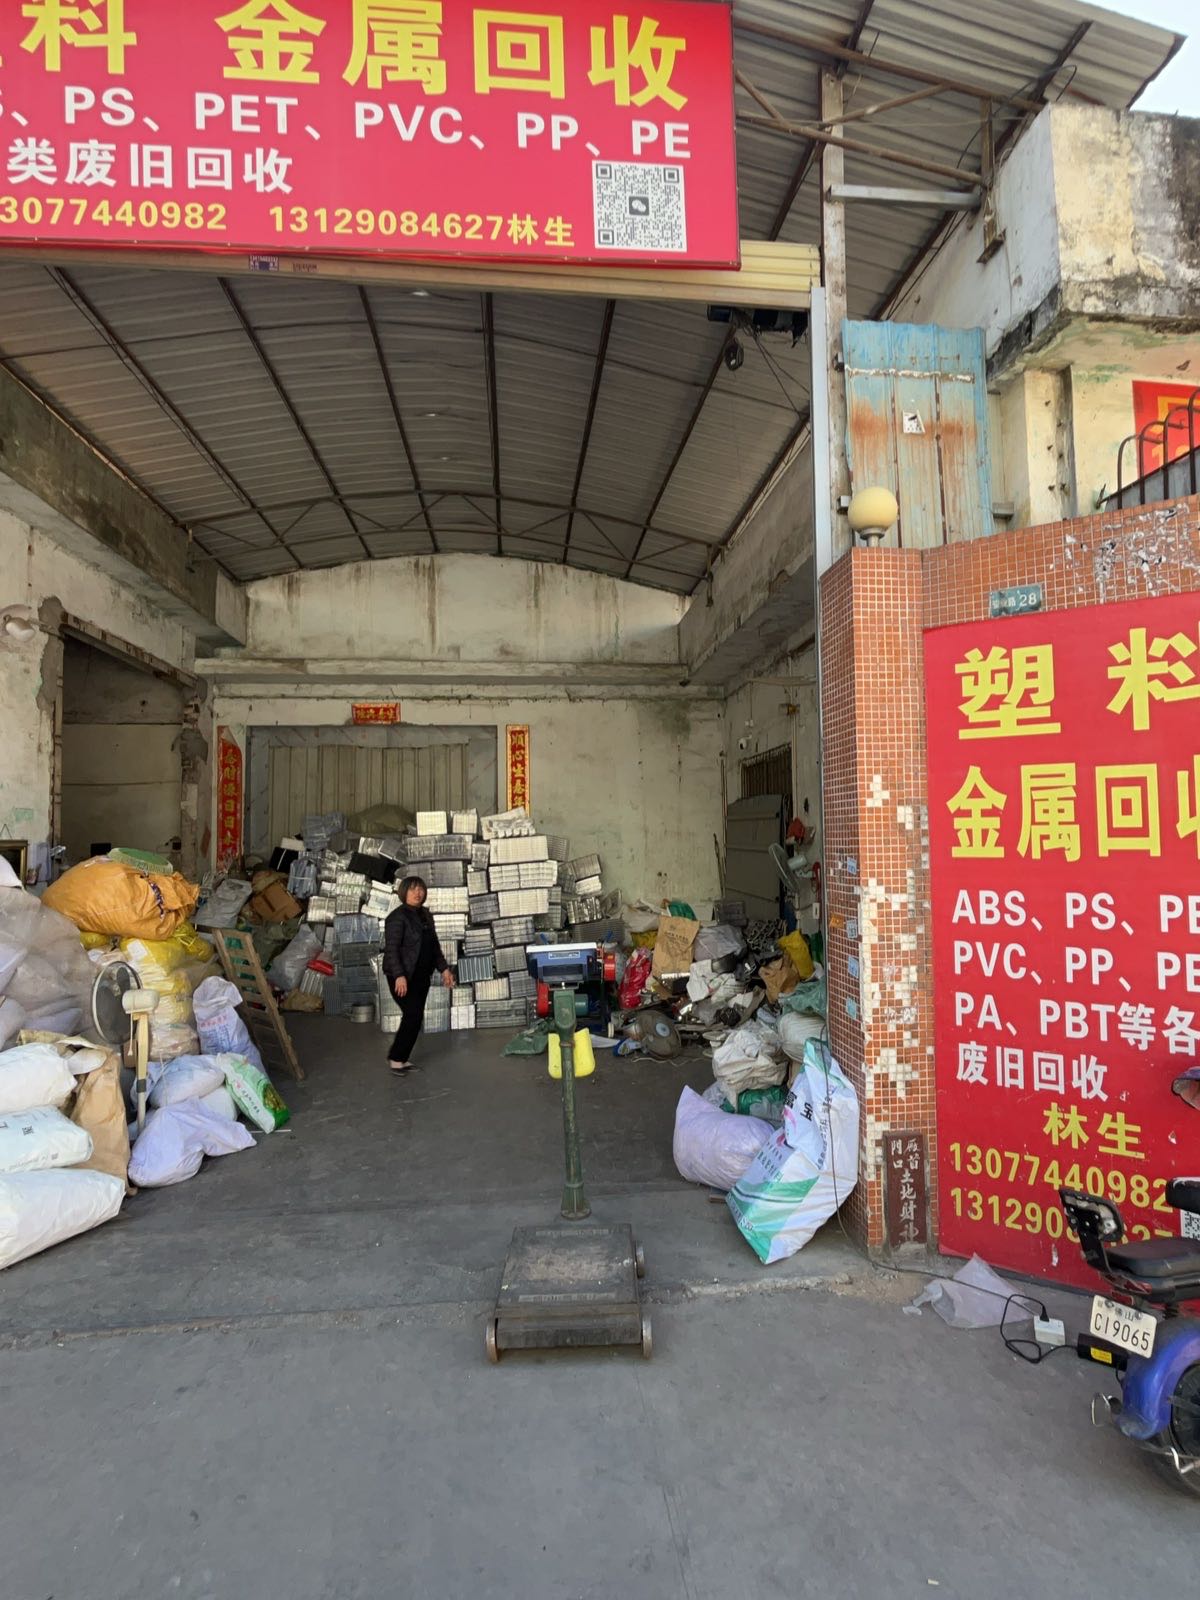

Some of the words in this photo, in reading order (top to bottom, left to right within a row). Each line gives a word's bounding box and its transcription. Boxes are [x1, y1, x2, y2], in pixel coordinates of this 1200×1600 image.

[215, 0, 689, 111] 金属回收
[7, 137, 293, 194] 类废旧回收
[1019, 592, 1037, 607] 28
[946, 754, 1200, 863] 金属回
[956, 1042, 1109, 1102] 废旧回收
[1042, 1102, 1146, 1159] 林生
[949, 1143, 1174, 1214] 13077440982
